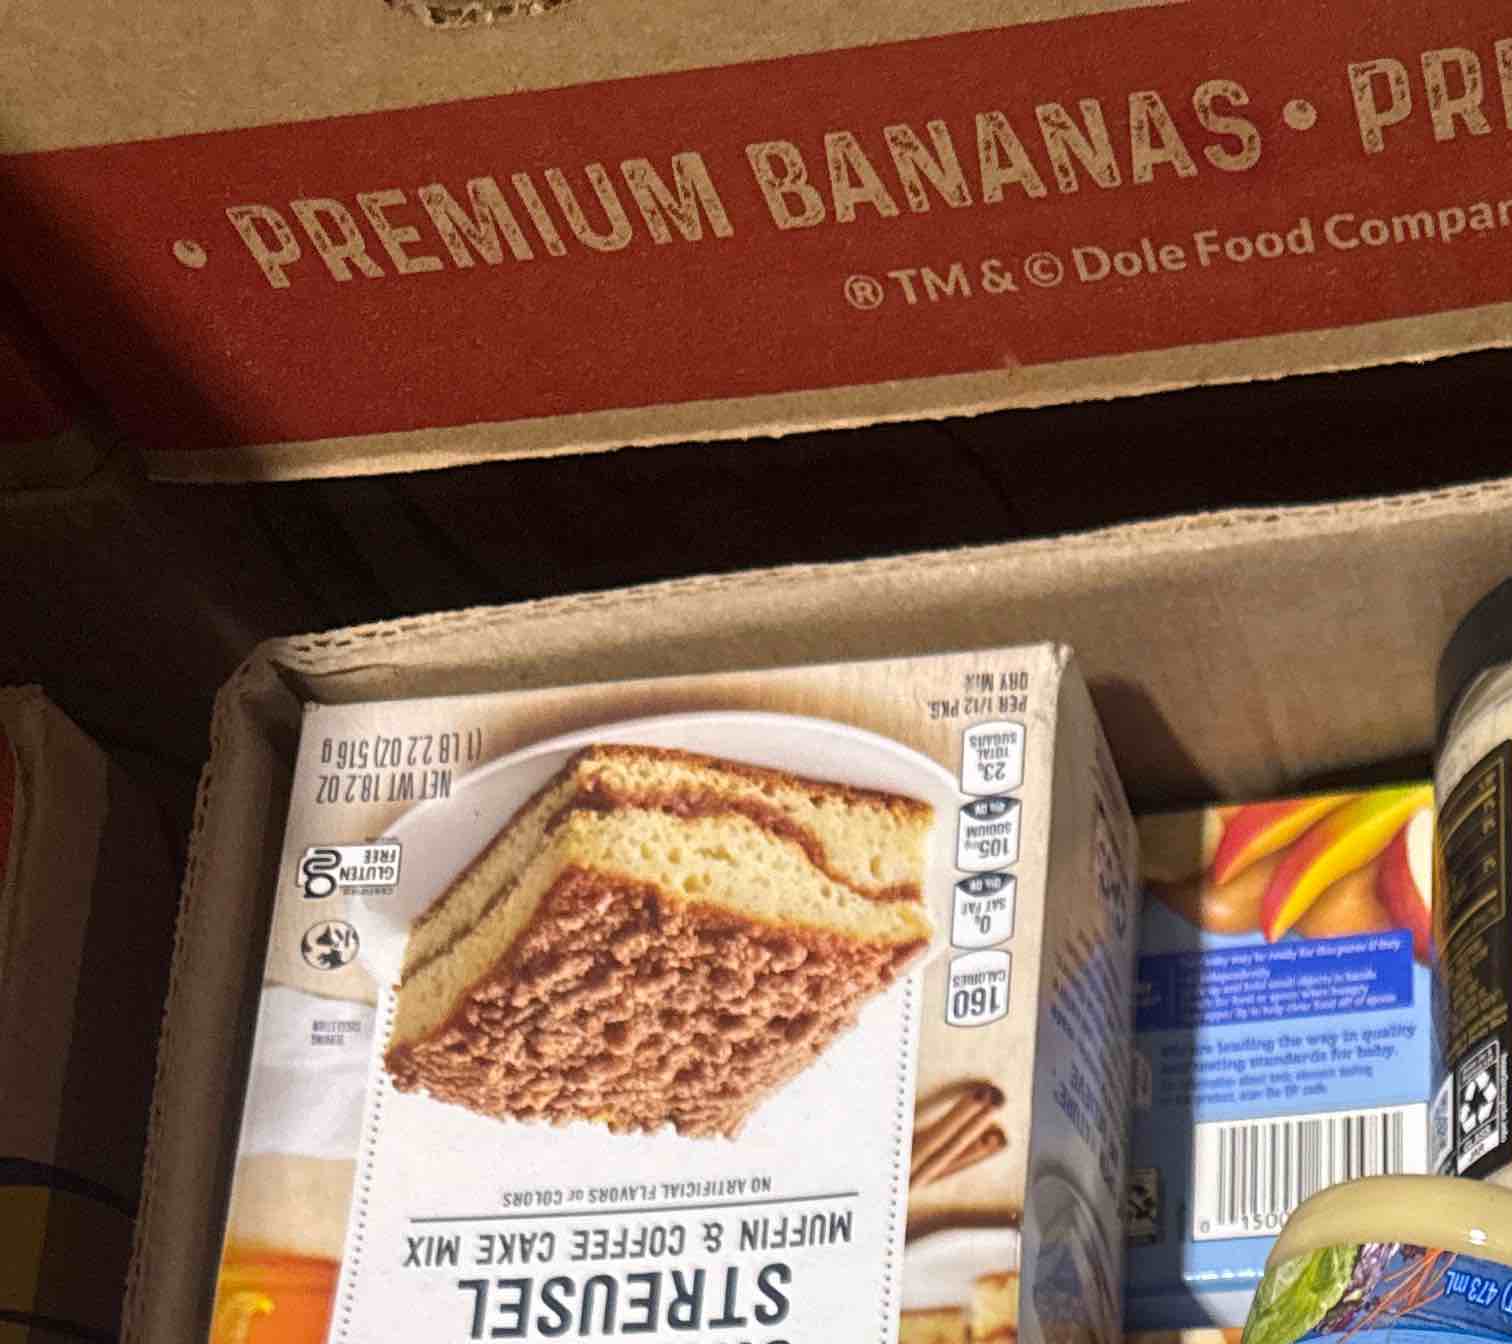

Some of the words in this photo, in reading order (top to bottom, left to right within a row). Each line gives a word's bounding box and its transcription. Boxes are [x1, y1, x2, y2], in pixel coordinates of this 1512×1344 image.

[225, 151, 733, 288] PREMIUM
[744, 79, 1260, 229] BANANAS
[887, 263, 971, 304] TM
[980, 258, 1018, 293] &
[1023, 252, 1063, 286] ©
[1071, 237, 1186, 281] Dole
[1193, 217, 1314, 266] Food
[321, 737, 332, 763] g
[338, 739, 368, 767] 516
[374, 735, 401, 767] OZ)
[406, 734, 432, 766] 2.2
[439, 732, 459, 763] LB
[467, 727, 481, 760] (1
[315, 775, 339, 804] OZ
[344, 773, 379, 803] 18.2
[387, 771, 413, 801] WT
[419, 770, 451, 799] NET
[364, 847, 396, 863] FREE
[340, 864, 395, 881] GLUTEN
[953, 988, 1001, 1018] 160
[570, 1224, 685, 1261] COFFEE
[702, 1221, 723, 1253] &
[739, 1210, 852, 1251] MUFFIN
[402, 1235, 460, 1266] MIX
[475, 1231, 555, 1265] CAKE
[457, 1262, 791, 1339] STREUSEL
